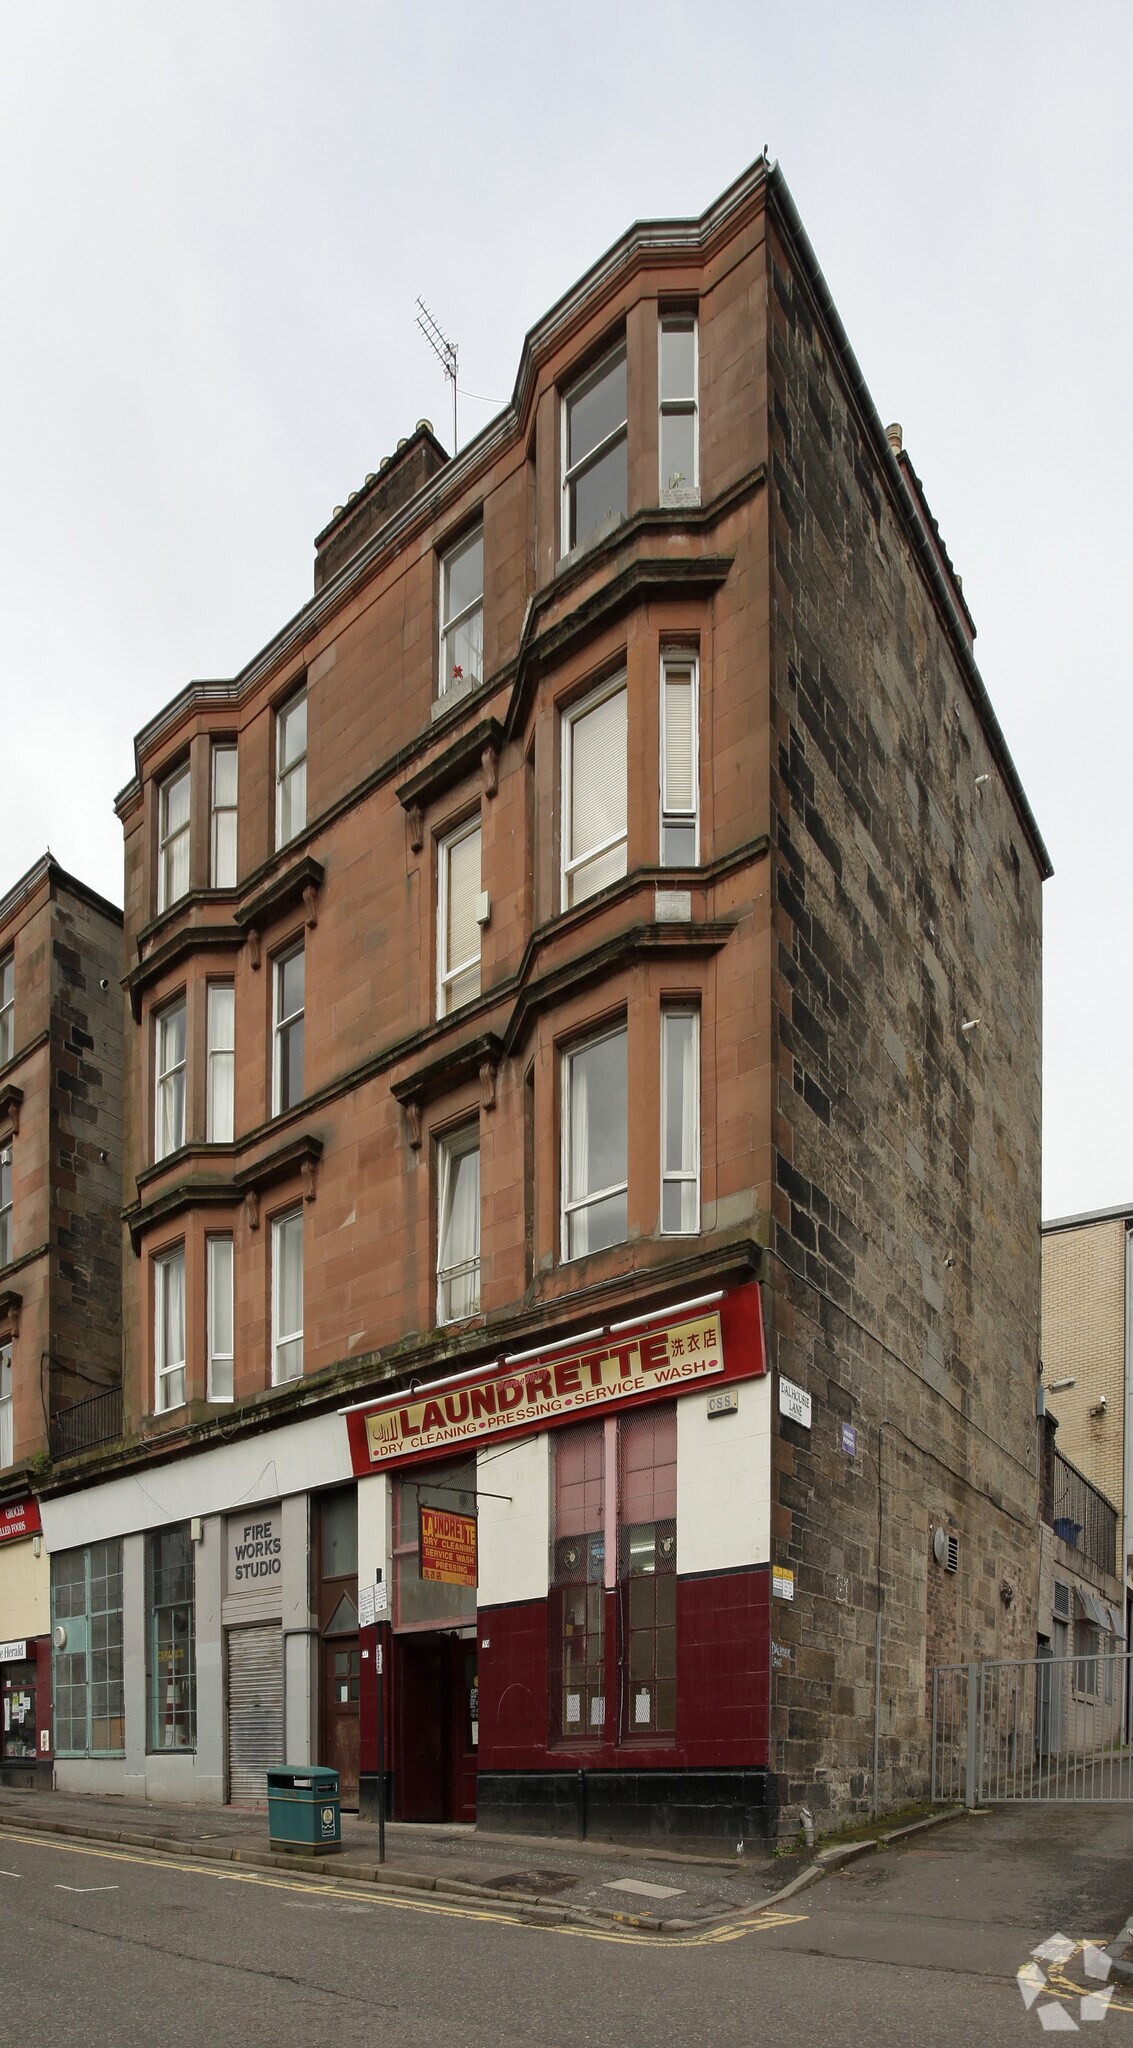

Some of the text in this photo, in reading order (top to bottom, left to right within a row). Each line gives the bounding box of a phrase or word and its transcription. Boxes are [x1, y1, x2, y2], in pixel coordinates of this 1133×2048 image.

[671, 1329, 717, 1357] 洗衣店
[400, 1333, 670, 1438] LAUNDRETTE
[781, 1382, 810, 1408] DALHOUSIE
[380, 1441, 404, 1456] DRY
[410, 1423, 477, 1448] CLEANING
[487, 1400, 562, 1428] PRESSING
[575, 1377, 645, 1405] SERVICE
[654, 1360, 706, 1383] WASH
[789, 1400, 803, 1417] LANE
[5, 1505, 25, 1519] GROCER
[11, 1521, 26, 1533] FOODS
[244, 1521, 272, 1542] FIRE
[422, 1515, 476, 1545] LAUNDRETTE
[235, 1538, 281, 1561] WORKS
[423, 1536, 475, 1554] DRY CLEANING
[425, 1548, 475, 1565] SERVICE WASH
[235, 1558, 281, 1580] STUDIO
[435, 1561, 468, 1574] PRESSING
[4, 1645, 24, 1659] Herald
